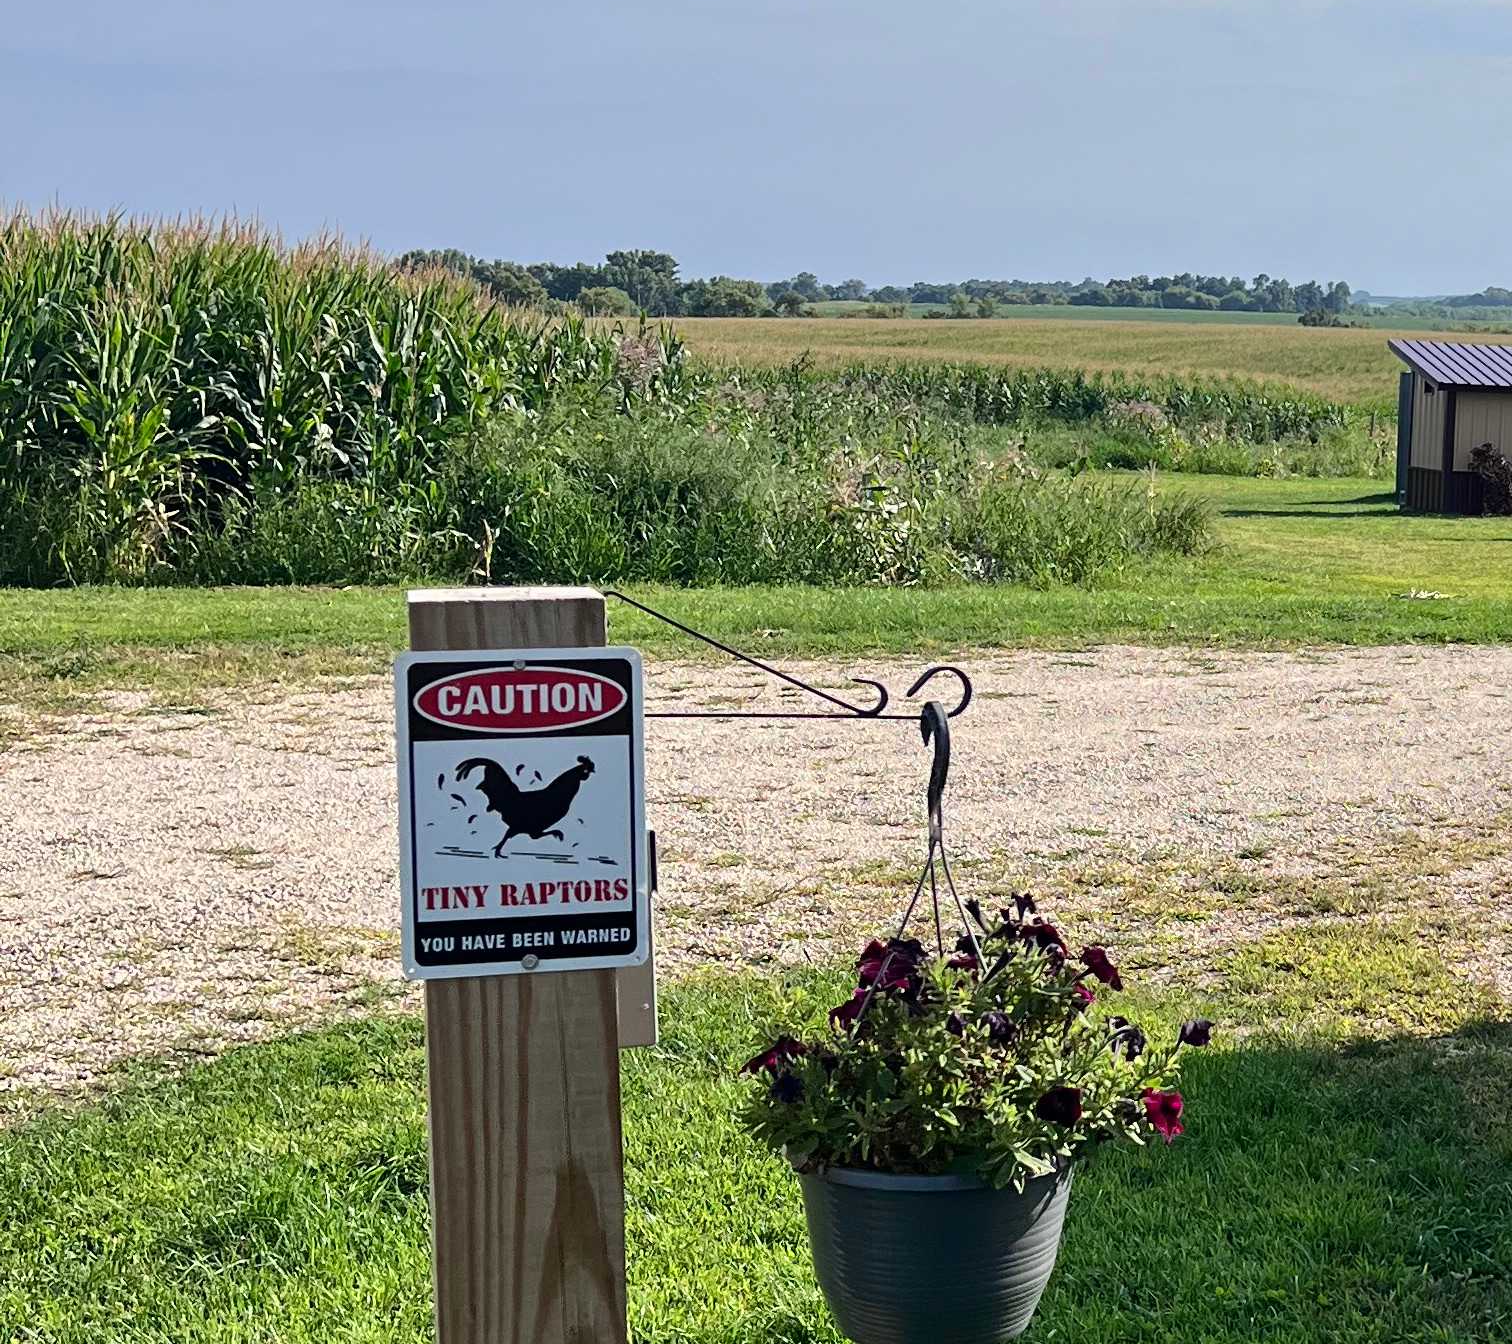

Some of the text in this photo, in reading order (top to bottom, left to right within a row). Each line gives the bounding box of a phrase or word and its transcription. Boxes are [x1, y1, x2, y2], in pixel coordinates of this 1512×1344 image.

[437, 682, 603, 716] CAUTION
[422, 878, 628, 910] TINY RAPTORS
[421, 927, 631, 953] YOU HAVE BEEN WARNED
